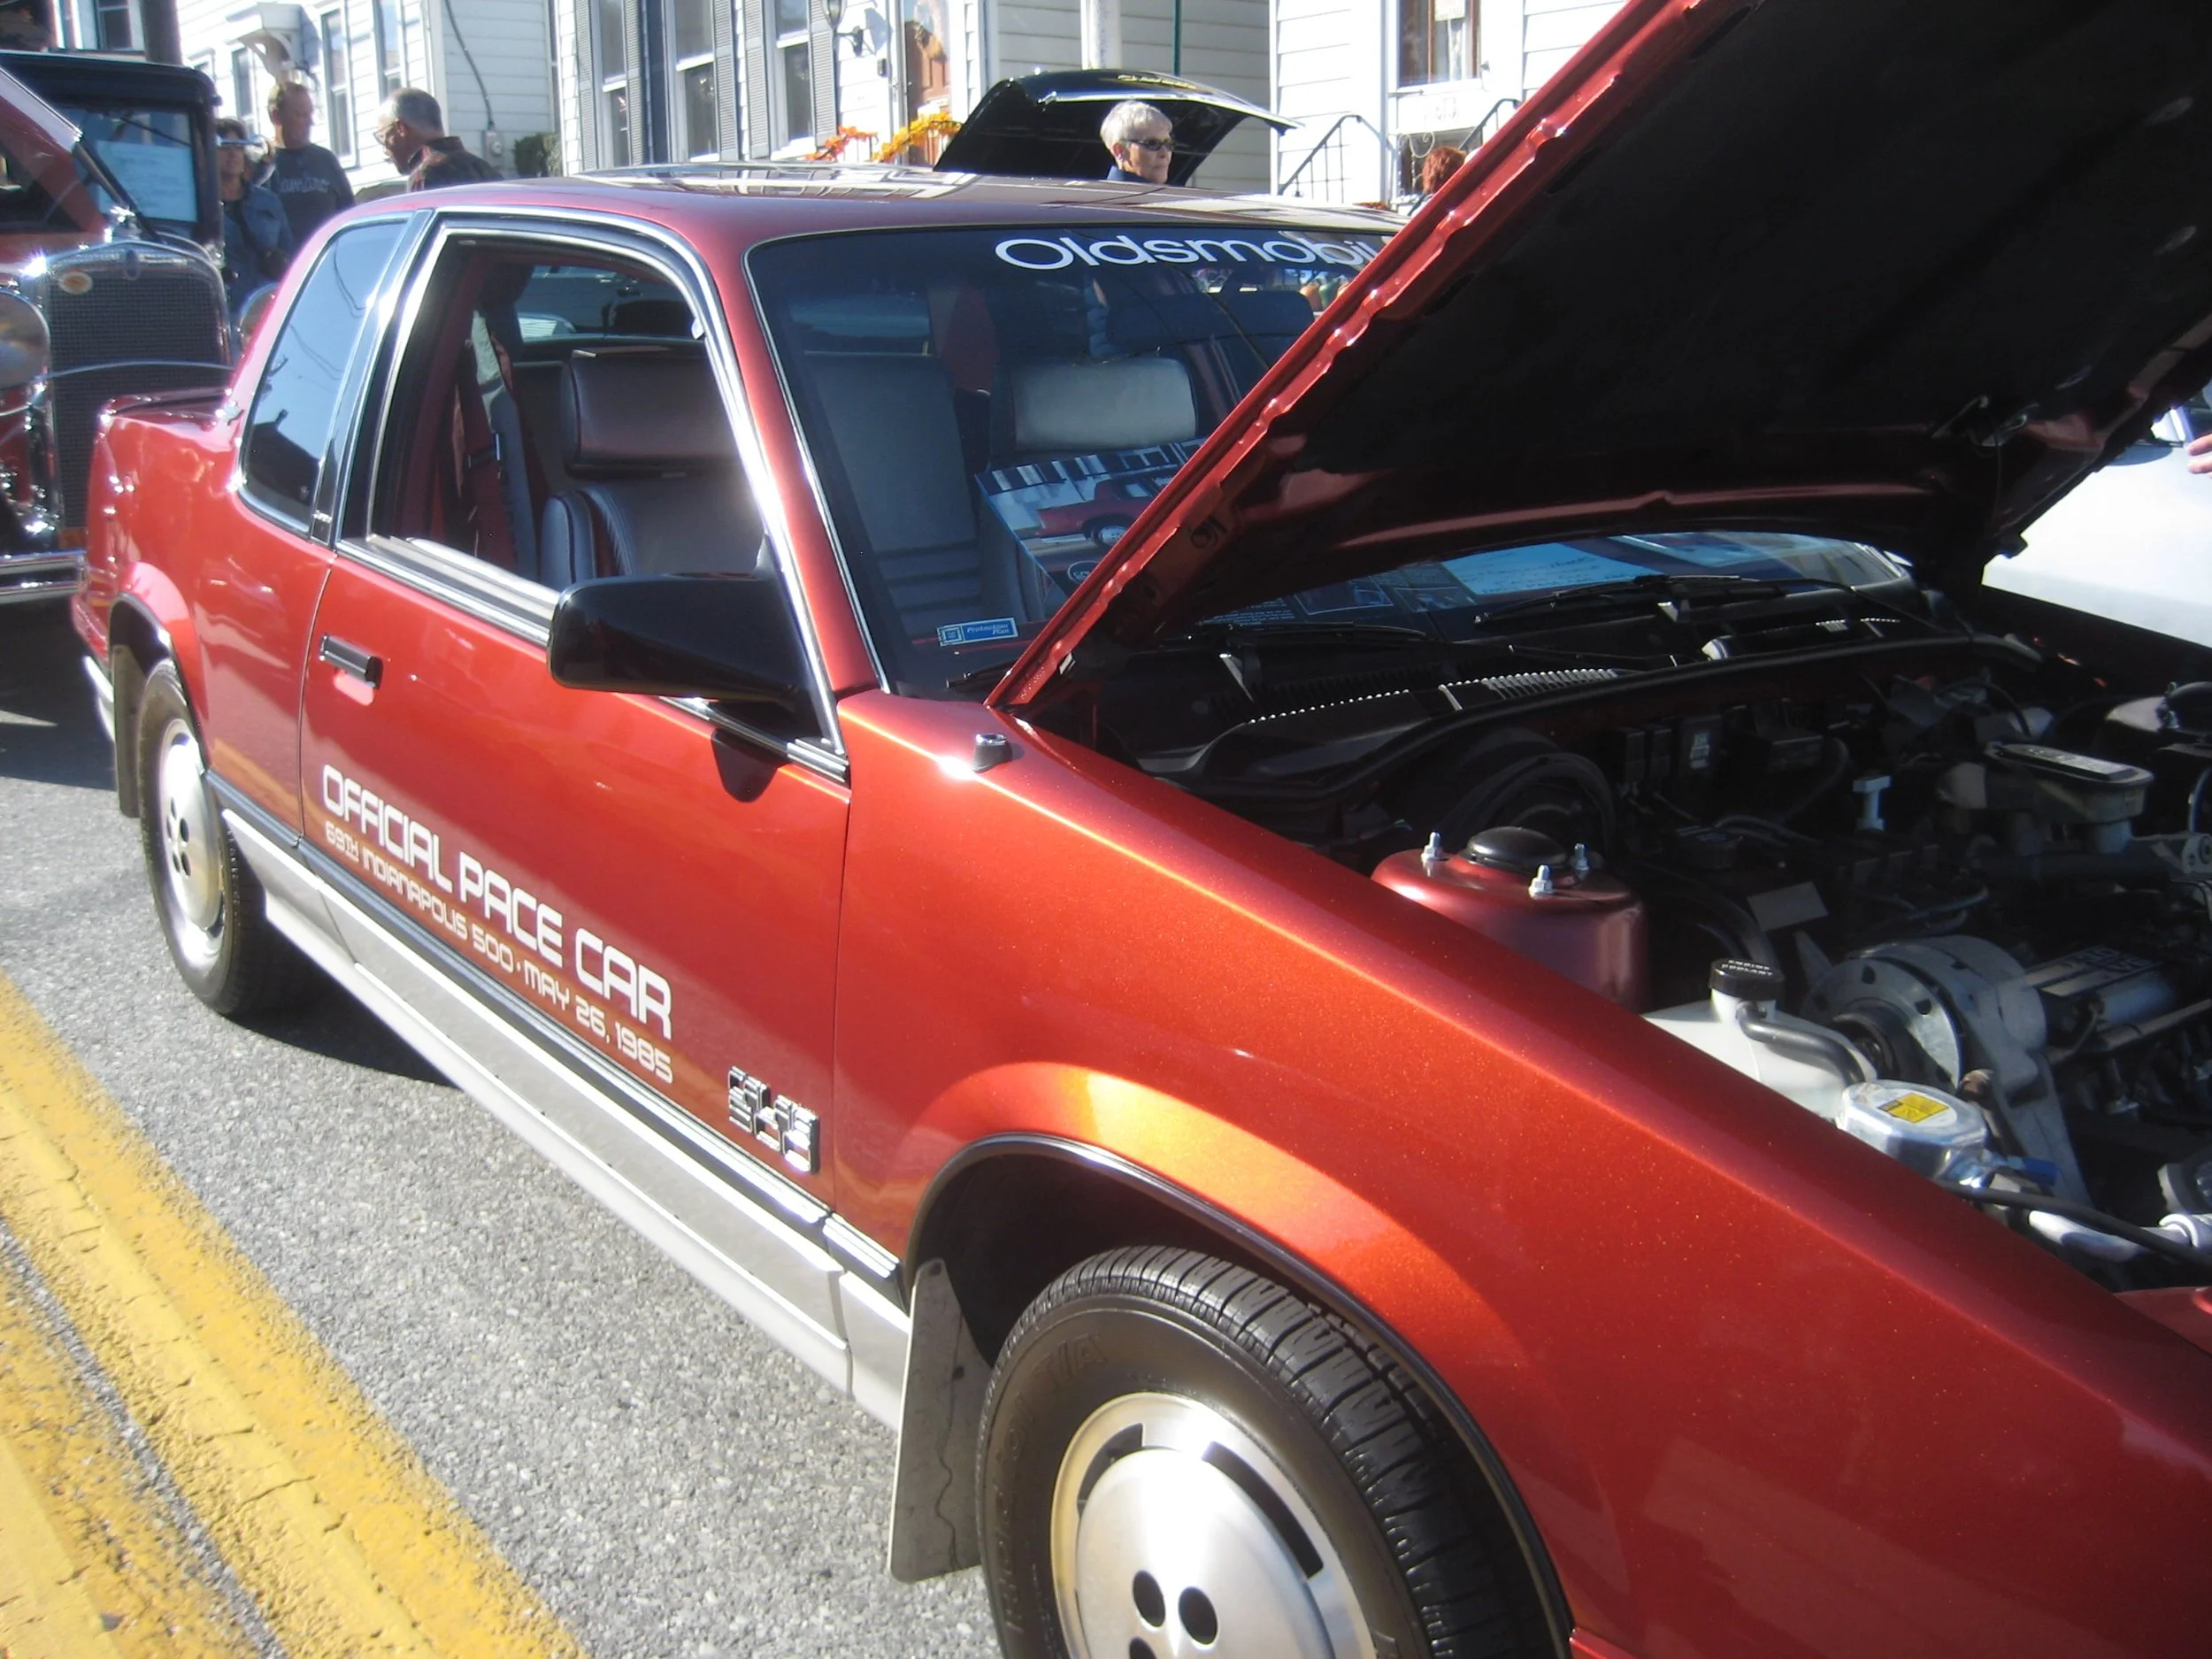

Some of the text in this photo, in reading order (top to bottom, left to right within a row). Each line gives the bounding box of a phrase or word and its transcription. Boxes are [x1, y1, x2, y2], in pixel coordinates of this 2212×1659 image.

[995, 234, 1379, 270] Oldsmobil
[322, 764, 672, 1041] OFFICIAL PACE CAR
[362, 845, 468, 941] INDIANAPOLIS
[472, 923, 514, 973] 500
[524, 959, 570, 1010] MAY
[615, 1020, 673, 1084] 1985
